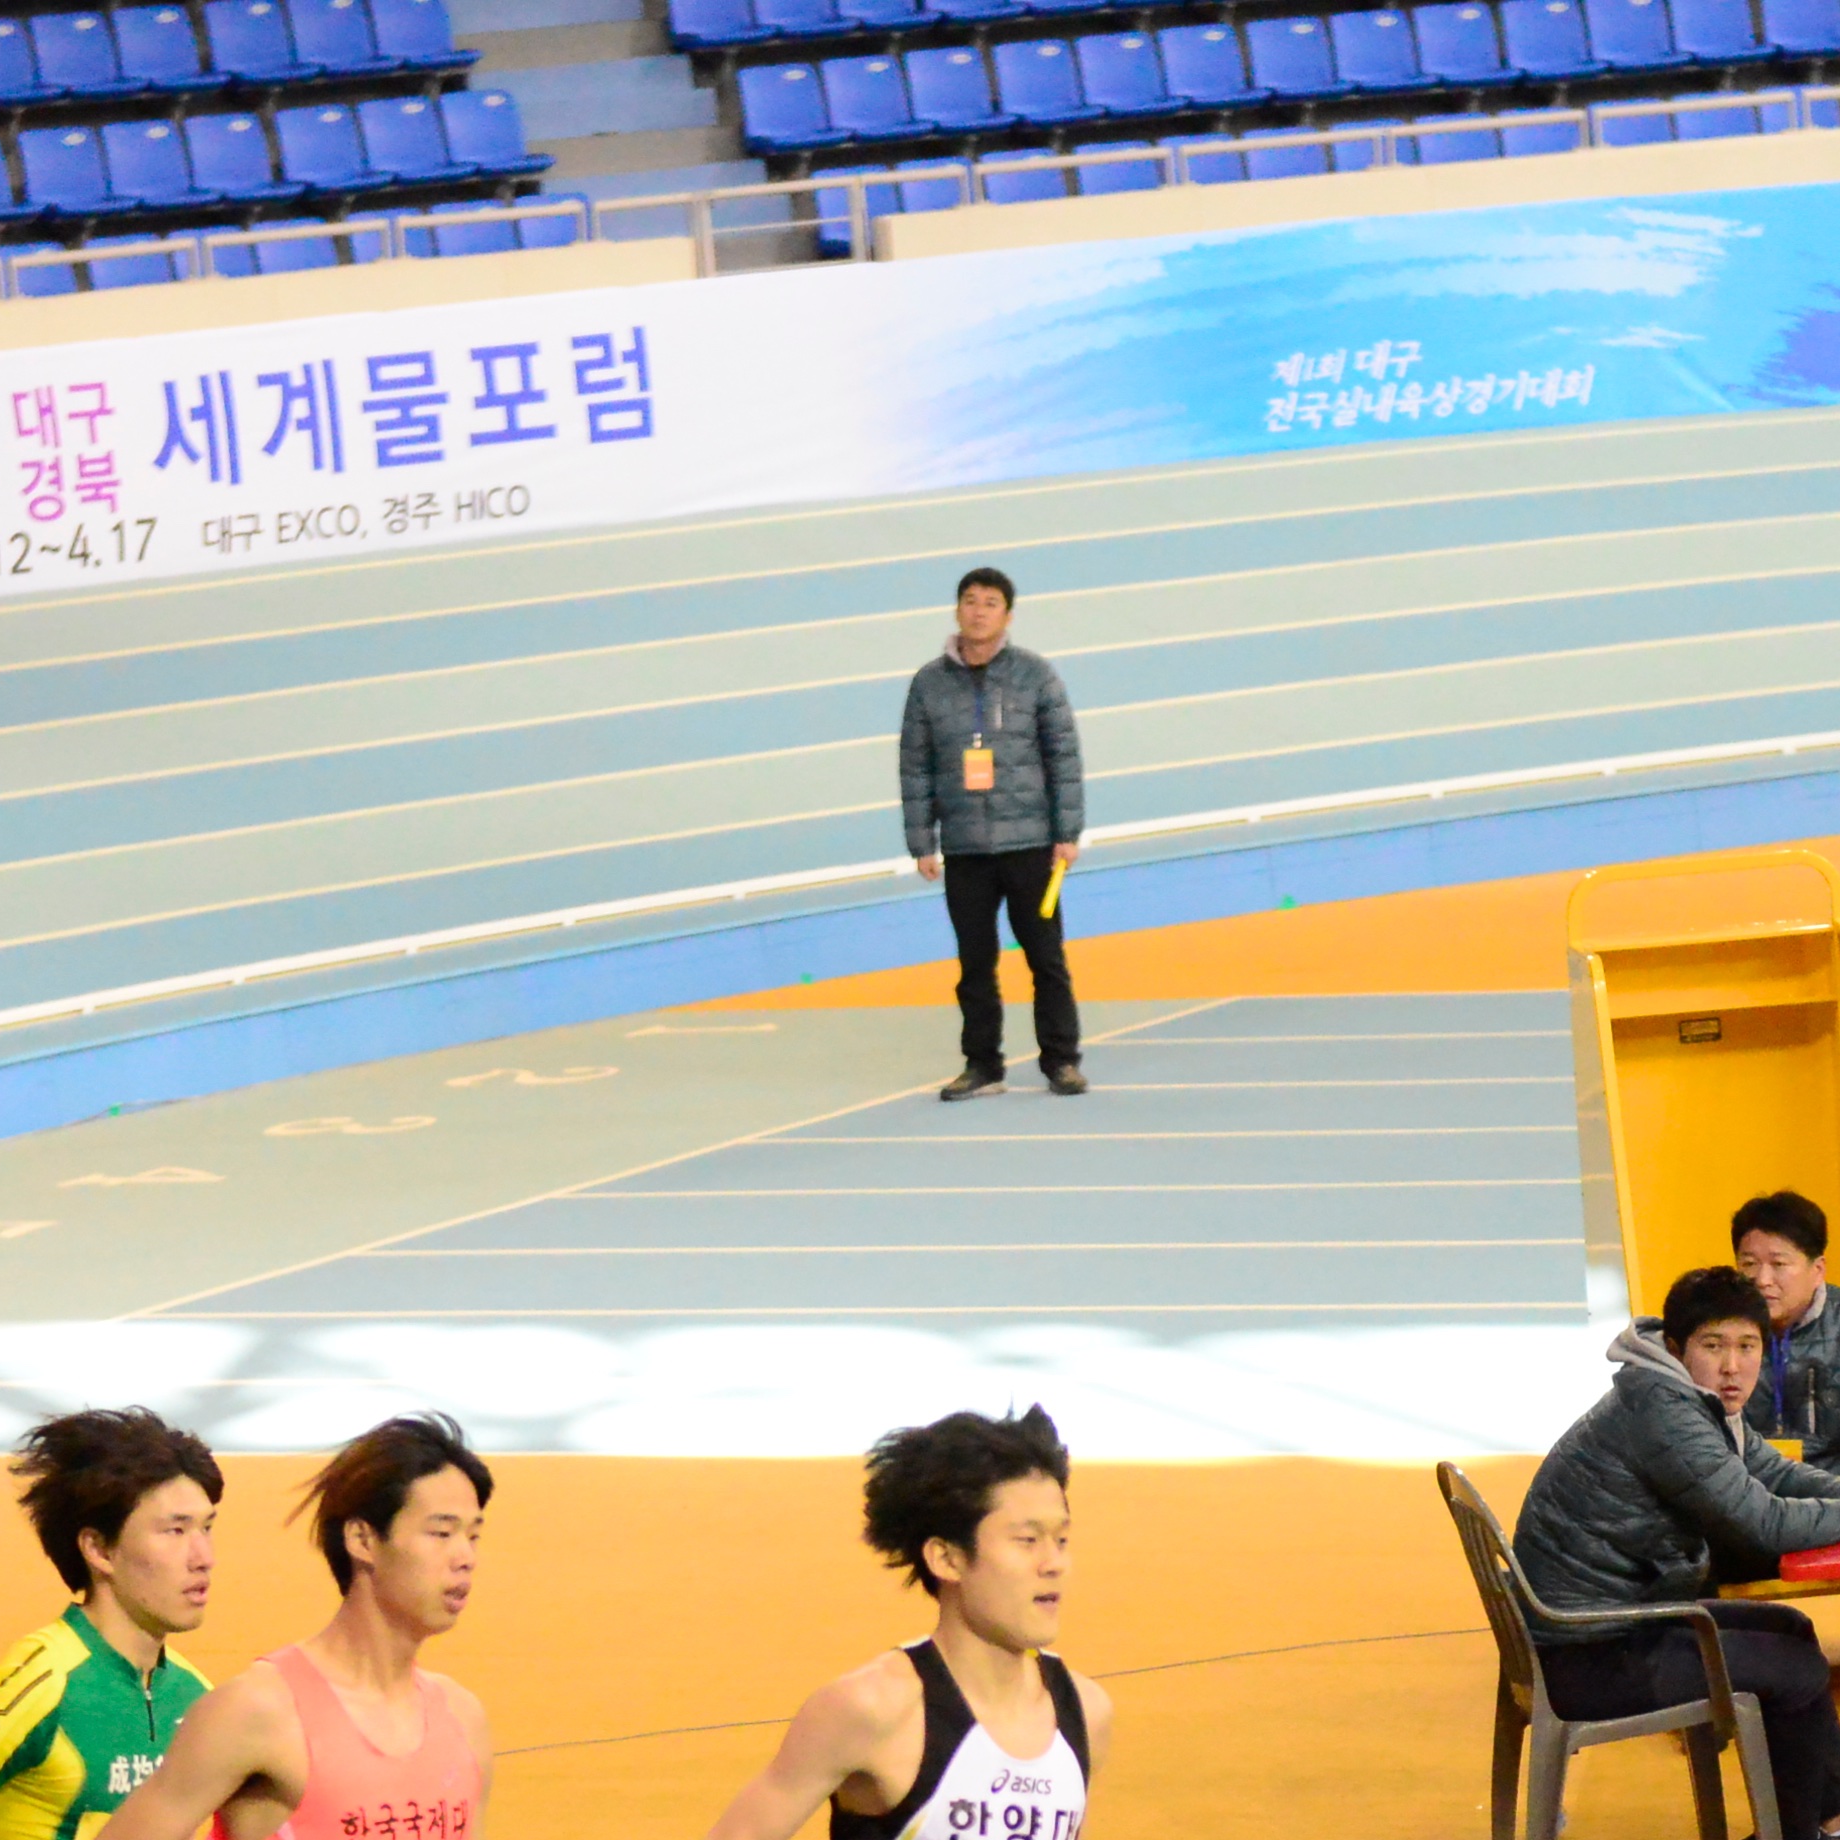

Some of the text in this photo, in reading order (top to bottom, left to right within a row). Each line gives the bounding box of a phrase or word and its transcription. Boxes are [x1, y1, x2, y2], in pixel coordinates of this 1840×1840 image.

[1272, 339, 1422, 388] 제1회 대구
[12, 381, 115, 448] 대구
[153, 326, 655, 486] 세계물포럼
[1264, 364, 1595, 433] 전국실내육상경기대회
[19, 451, 122, 523] 경북
[203, 484, 530, 554] 대구 EXCO, 경주 HICO
[108, 1754, 164, 1794] 成均
[1011, 1775, 1052, 1795] asics
